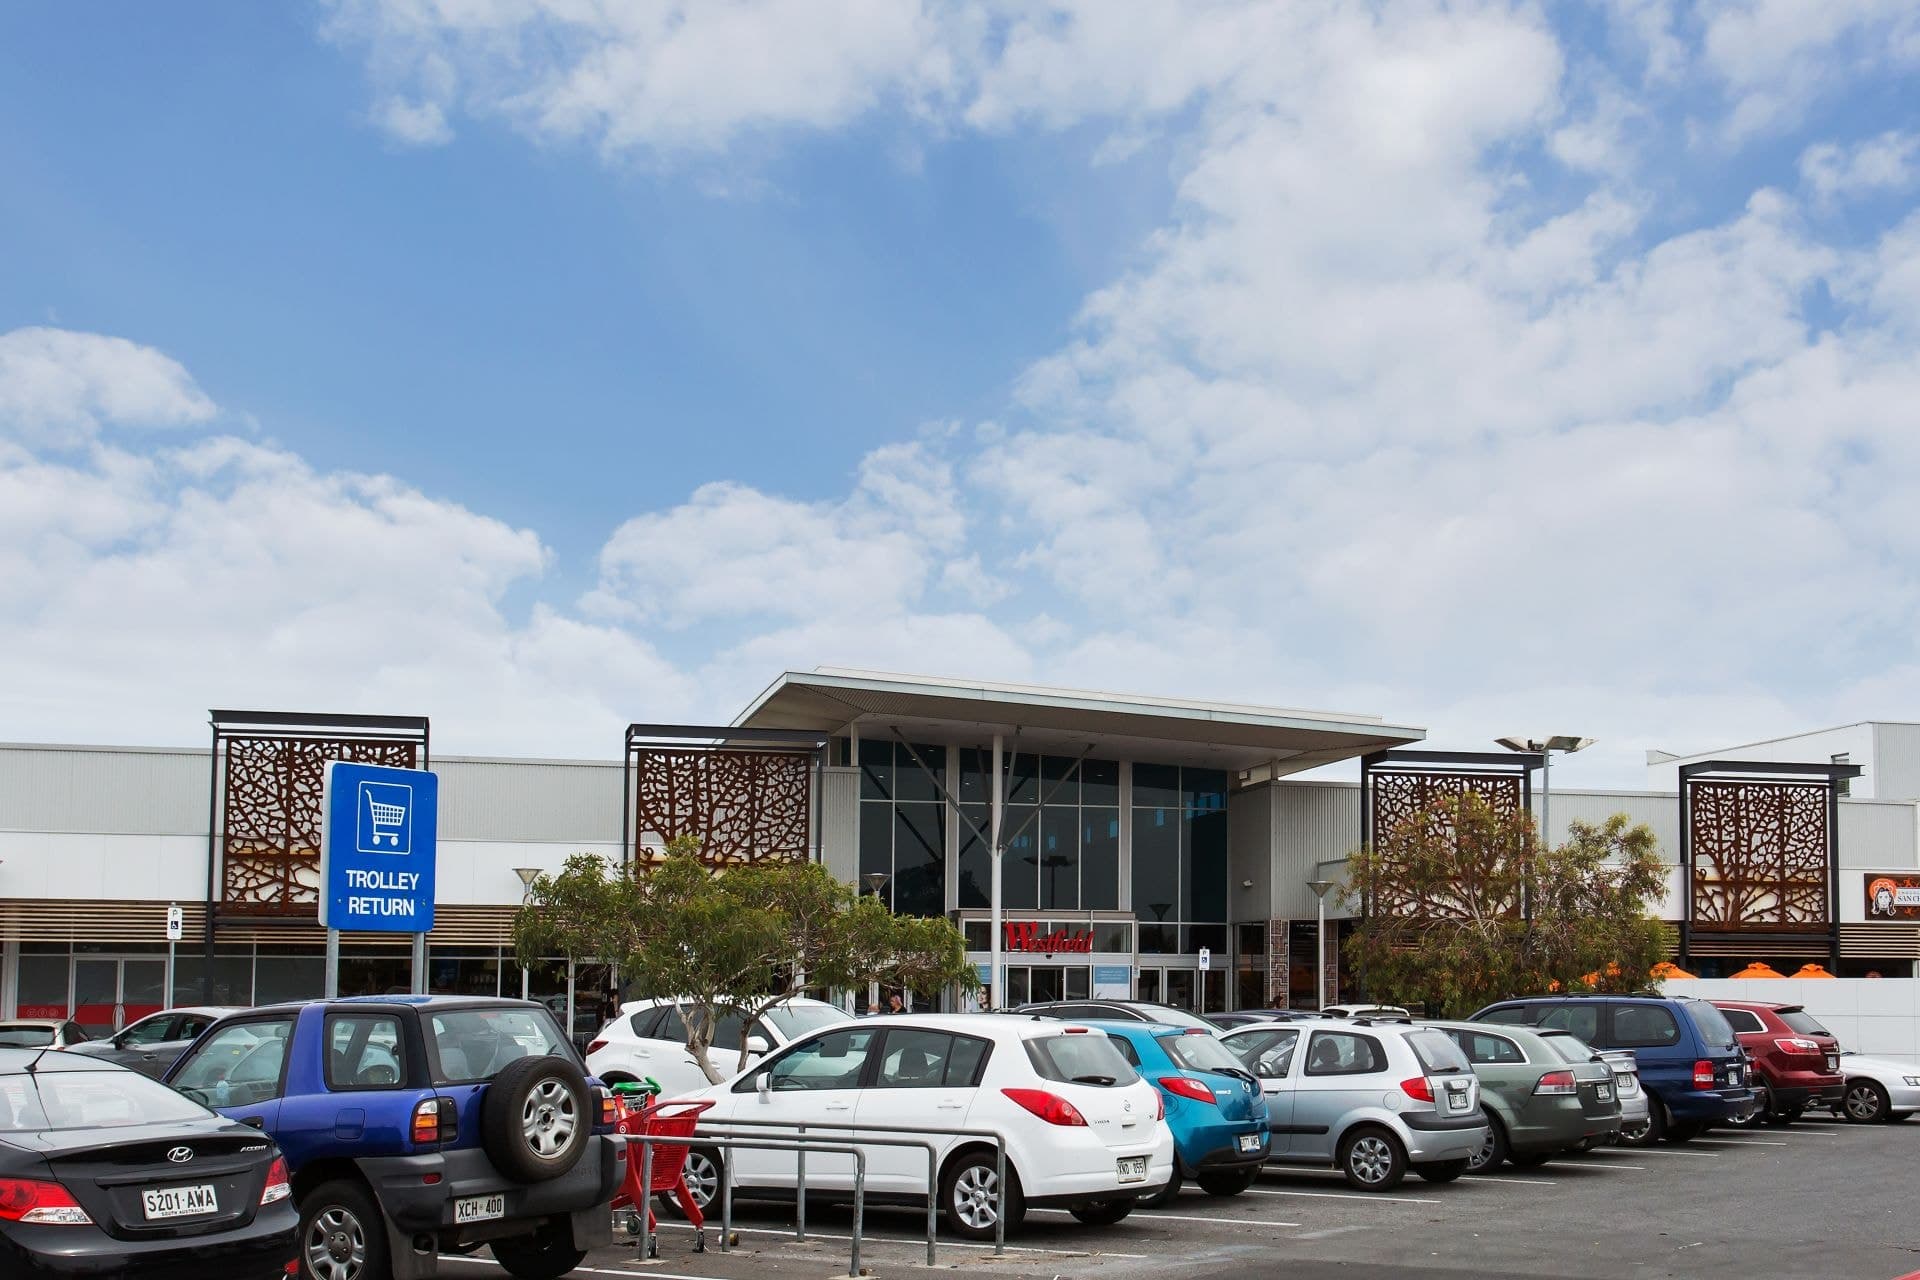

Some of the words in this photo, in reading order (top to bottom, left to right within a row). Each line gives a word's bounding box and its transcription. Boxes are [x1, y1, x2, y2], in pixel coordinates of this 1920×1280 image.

[345, 869, 419, 890] TROLLEY
[348, 896, 415, 916] RETURN
[1004, 921, 1095, 953] Westfield
[458, 1200, 478, 1218] XCH
[486, 1198, 502, 1213] 400
